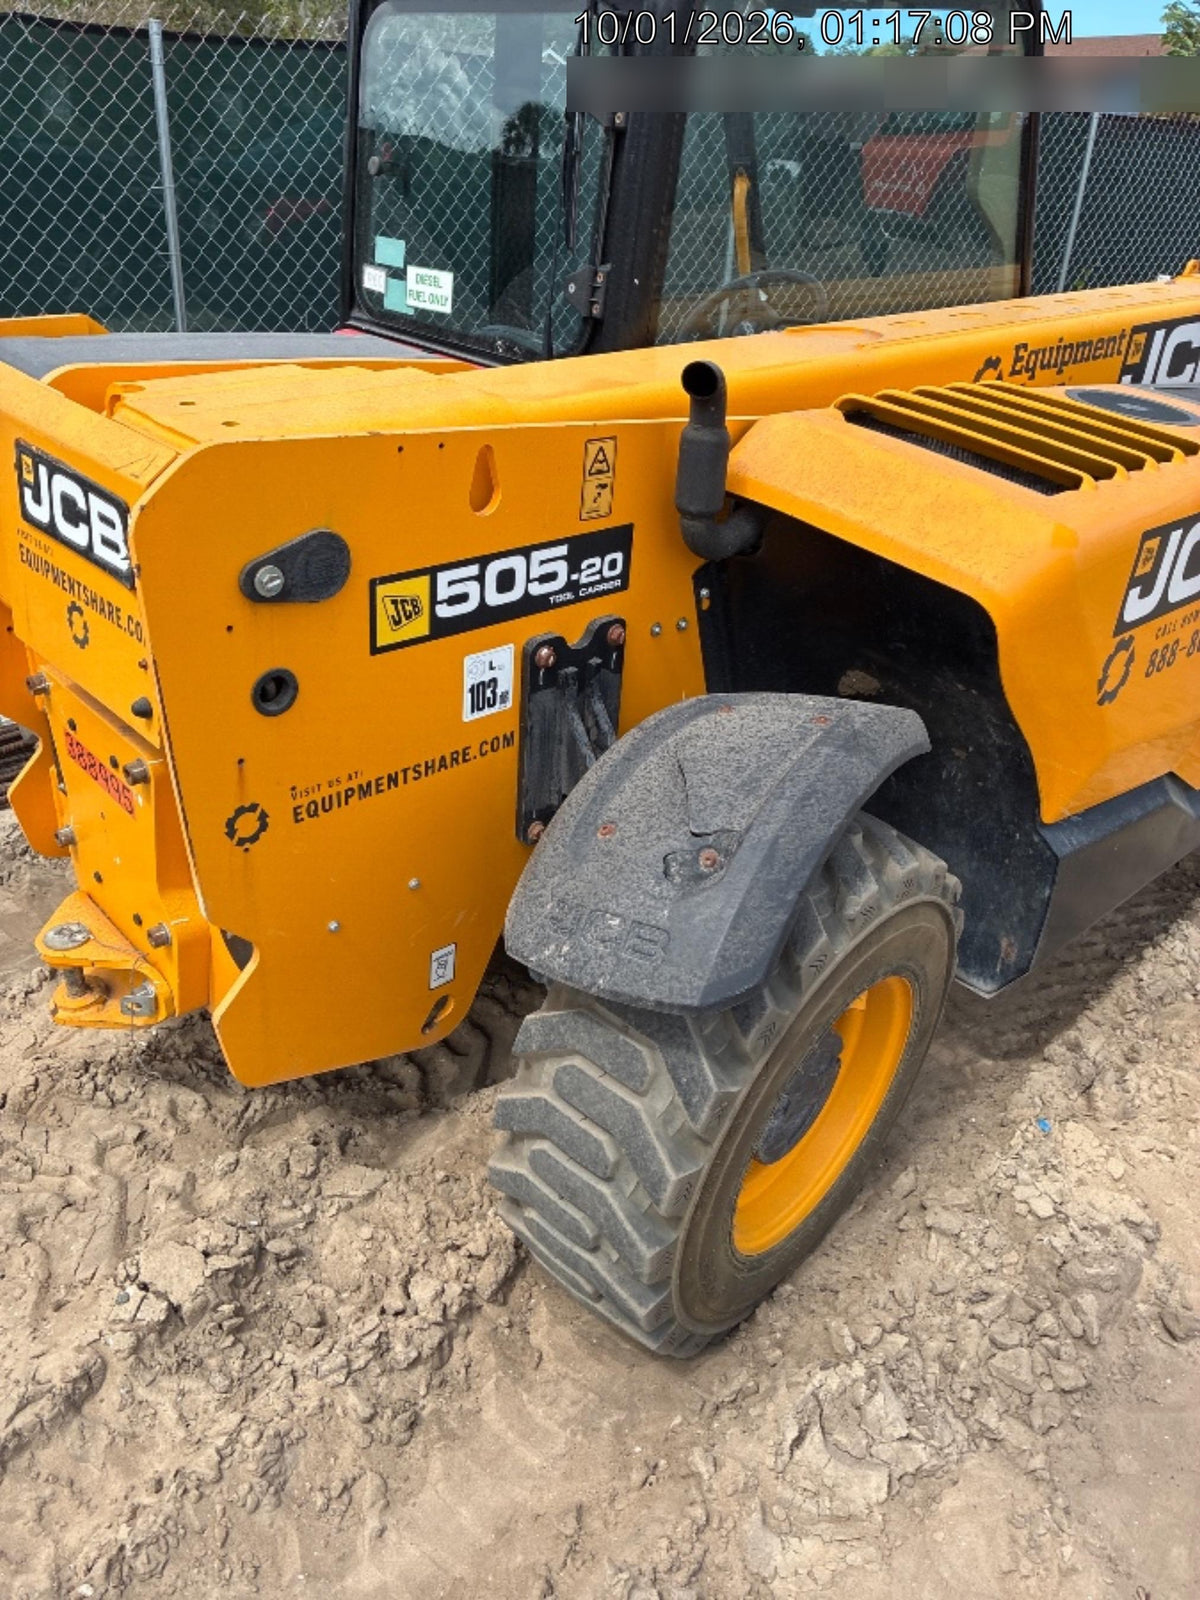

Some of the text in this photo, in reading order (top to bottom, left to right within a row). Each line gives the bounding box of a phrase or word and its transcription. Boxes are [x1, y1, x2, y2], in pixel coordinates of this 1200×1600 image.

[408, 289, 449, 306] FUEL ONLY
[415, 273, 443, 288] DIESEL
[1008, 329, 1127, 381] Equipment
[1120, 321, 1200, 384] JC
[23, 463, 131, 572] JCB
[19, 542, 147, 648] EQUIPMENTSHARE.CO
[390, 543, 624, 628] JCB 505-20
[549, 591, 575, 606] TOOL
[1144, 628, 1200, 679] 888-8
[469, 677, 498, 714] 103
[290, 783, 322, 800] VISIT
[328, 776, 343, 789] US
[292, 731, 515, 824] EQUIPMENTSHARE.COM
